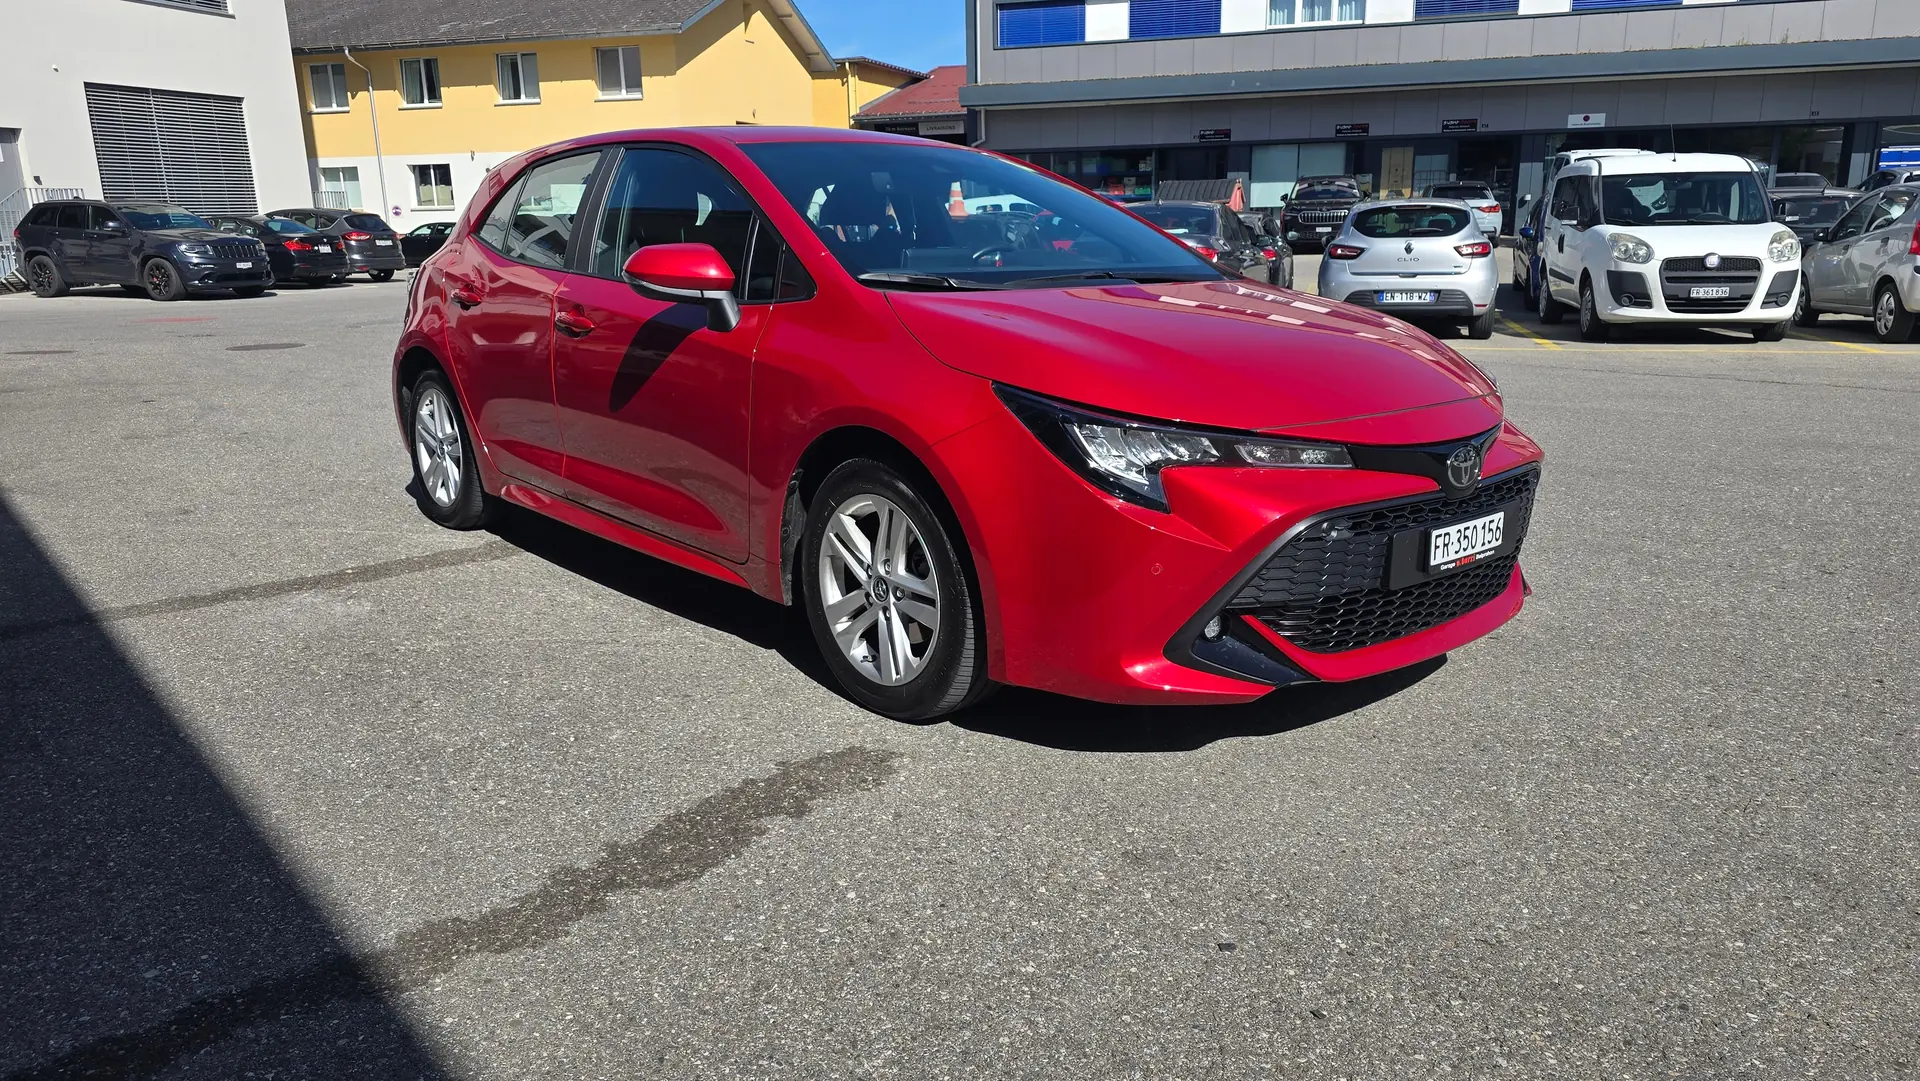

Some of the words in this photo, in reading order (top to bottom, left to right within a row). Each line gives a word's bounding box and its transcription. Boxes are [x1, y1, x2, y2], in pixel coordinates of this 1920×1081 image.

[1715, 288, 1728, 296] 836
[1481, 517, 1502, 547] 156
[1440, 562, 1456, 571] Garage
